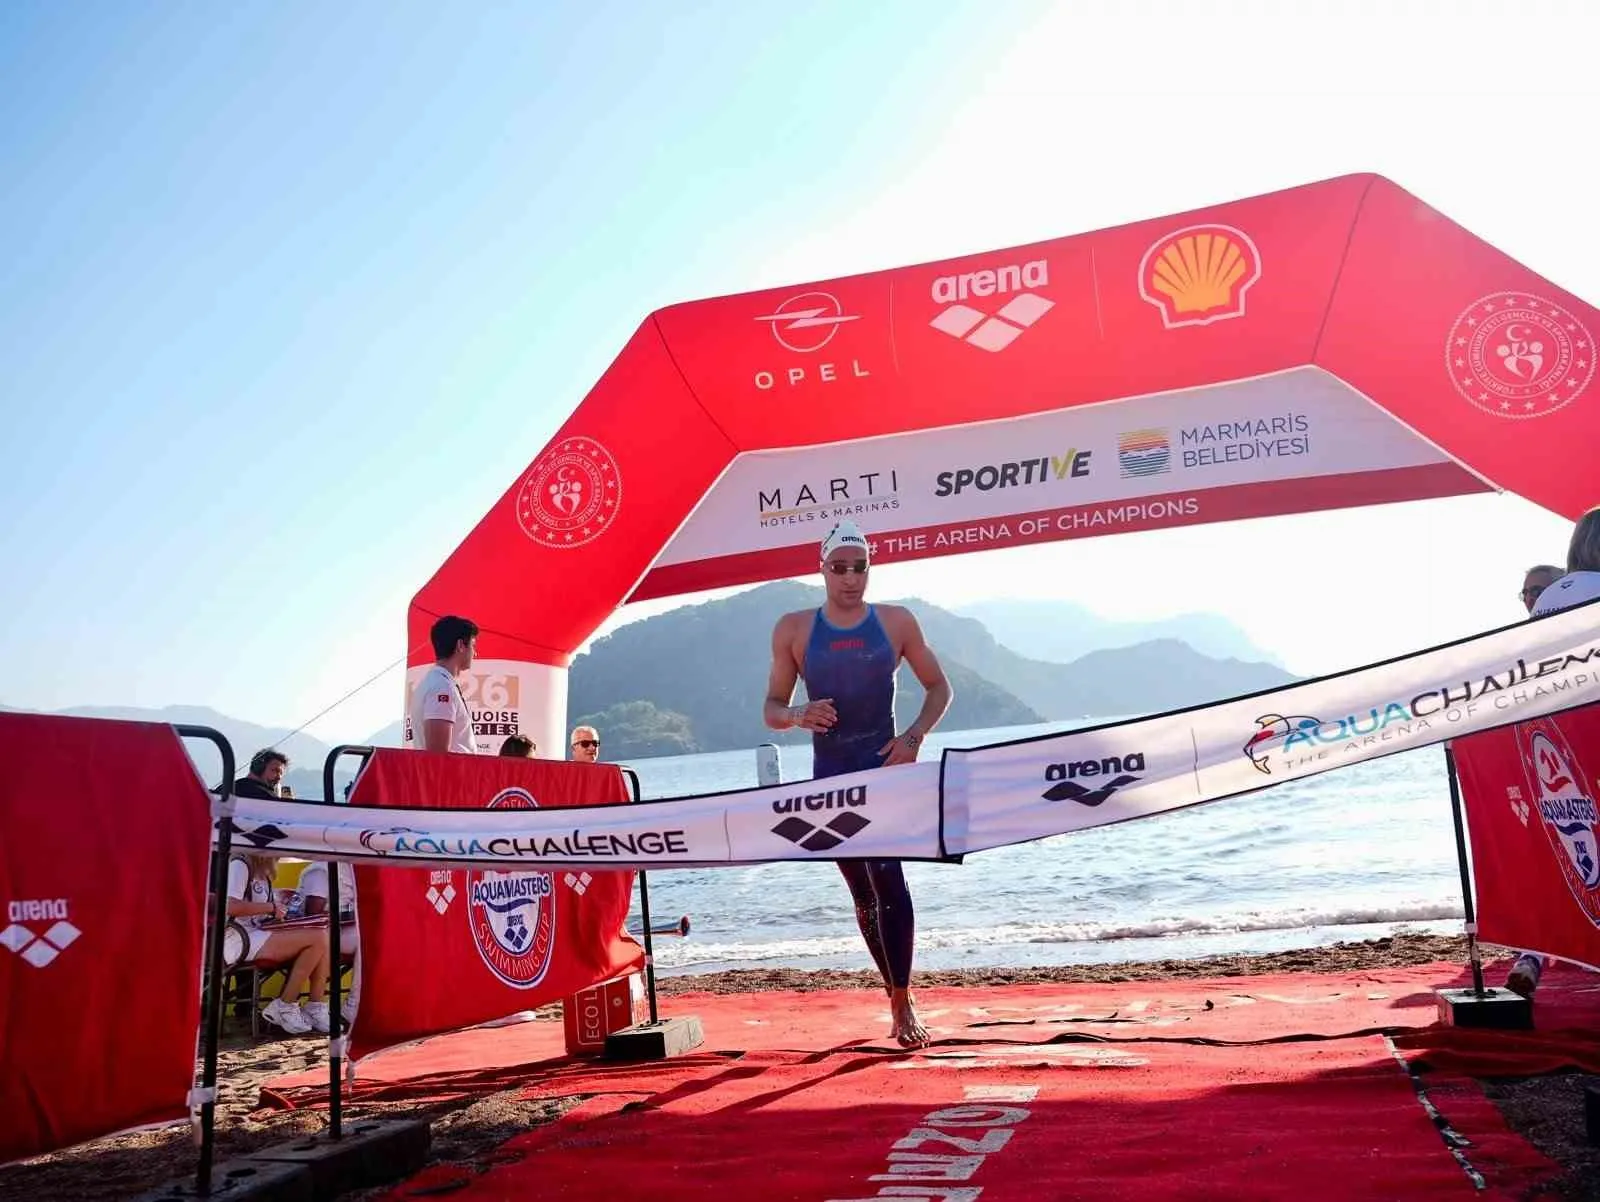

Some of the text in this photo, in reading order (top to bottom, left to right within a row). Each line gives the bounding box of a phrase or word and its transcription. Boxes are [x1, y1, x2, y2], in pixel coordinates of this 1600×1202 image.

[931, 259, 1049, 304] arena
[755, 359, 869, 390] OPEL
[1181, 412, 1309, 446] MARMARİS
[1182, 434, 1310, 468] BELEDİYESİ
[935, 447, 1092, 497] SPORTIVE
[758, 470, 898, 513] MARTI
[760, 500, 900, 528] HOTELS & MARINAS
[884, 534, 927, 553] THE
[934, 524, 1012, 548] ARENA
[1019, 517, 1050, 536] OF
[1057, 498, 1200, 531] CHAMPIONS
[1283, 648, 1600, 754] AQUACHALLEN
[1285, 751, 1329, 769] THE
[1344, 719, 1432, 752] ARENA
[1446, 704, 1479, 723] OF
[1044, 752, 1145, 782] arena
[395, 829, 688, 857] AQUACHALLENGE
[473, 876, 550, 902] AQUAMASTERS
[8, 898, 68, 922] arena
